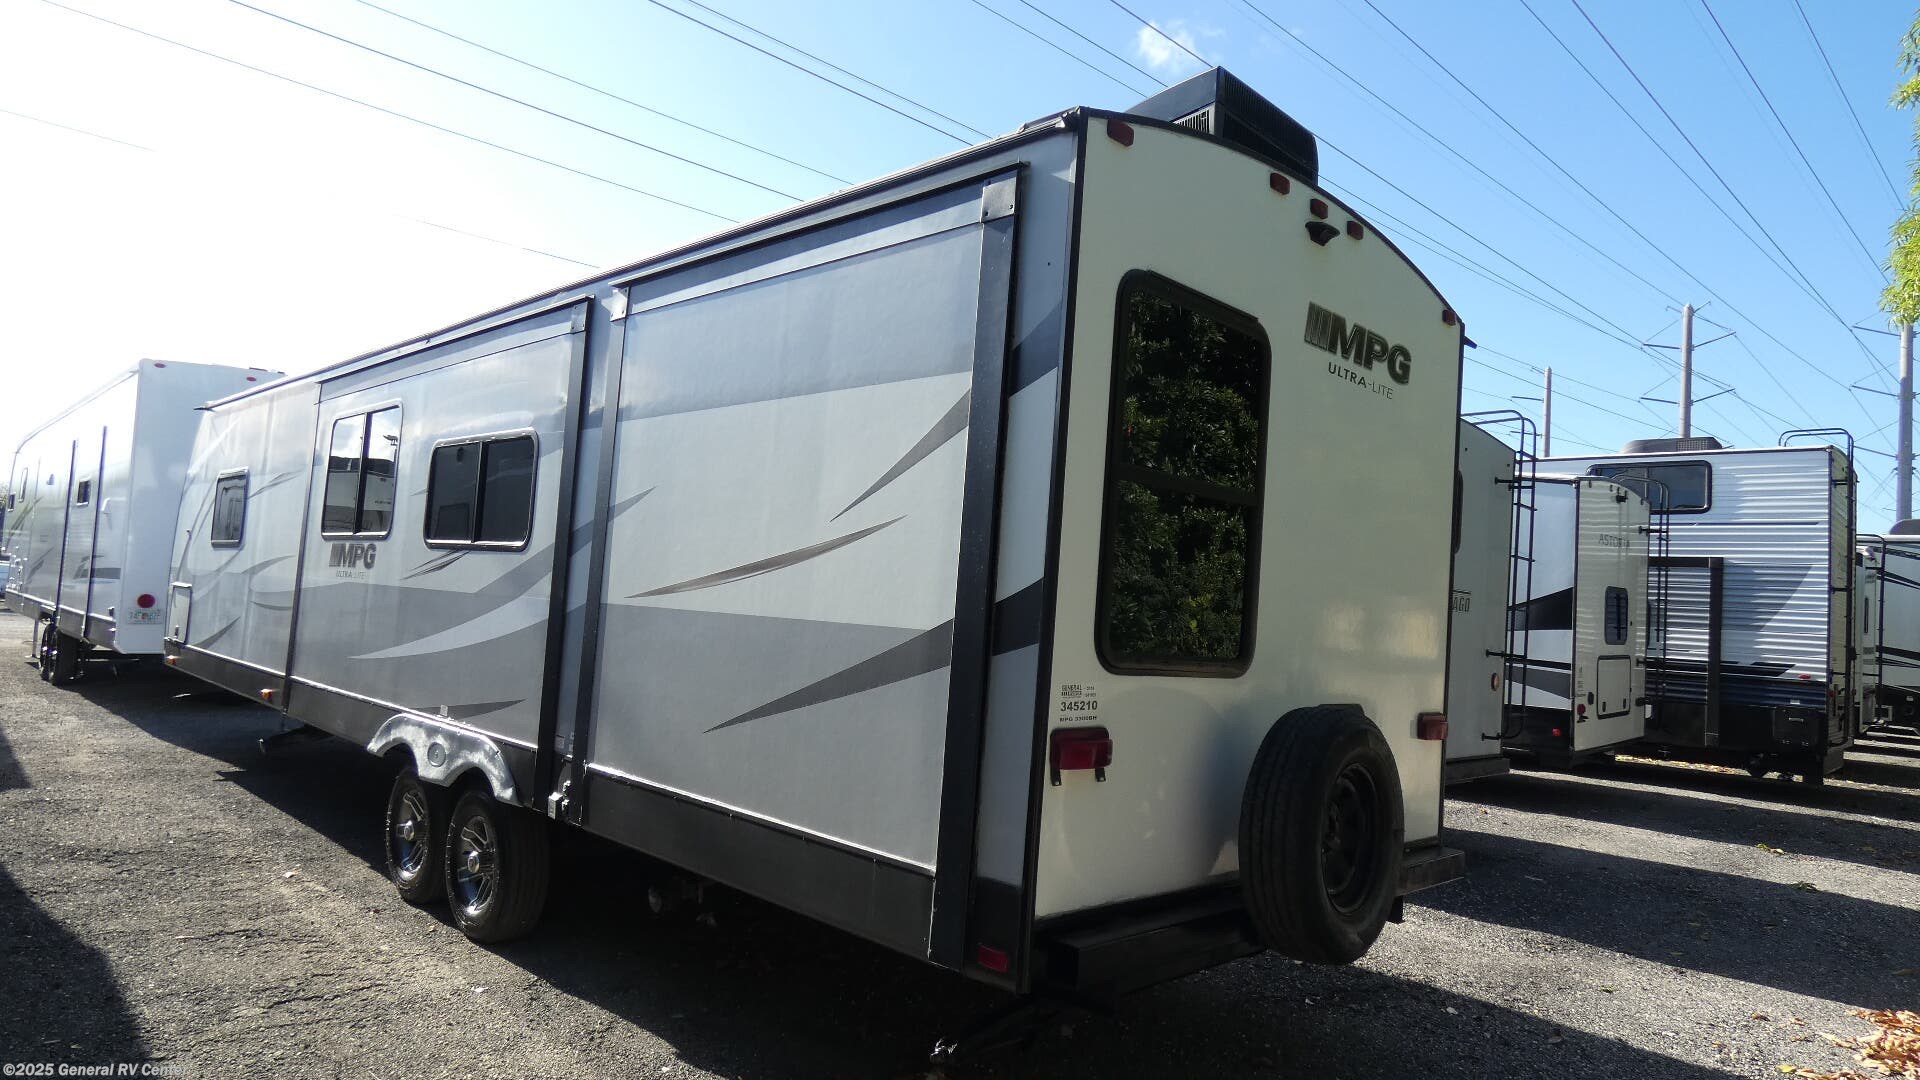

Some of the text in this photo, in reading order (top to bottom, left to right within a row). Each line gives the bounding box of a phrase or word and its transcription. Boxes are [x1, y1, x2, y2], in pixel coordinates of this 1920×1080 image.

[1328, 313, 1412, 385] MPG
[1328, 361, 1395, 400] ULTRA-LITE
[337, 543, 377, 569] MPG
[1060, 700, 1098, 712] 345210
